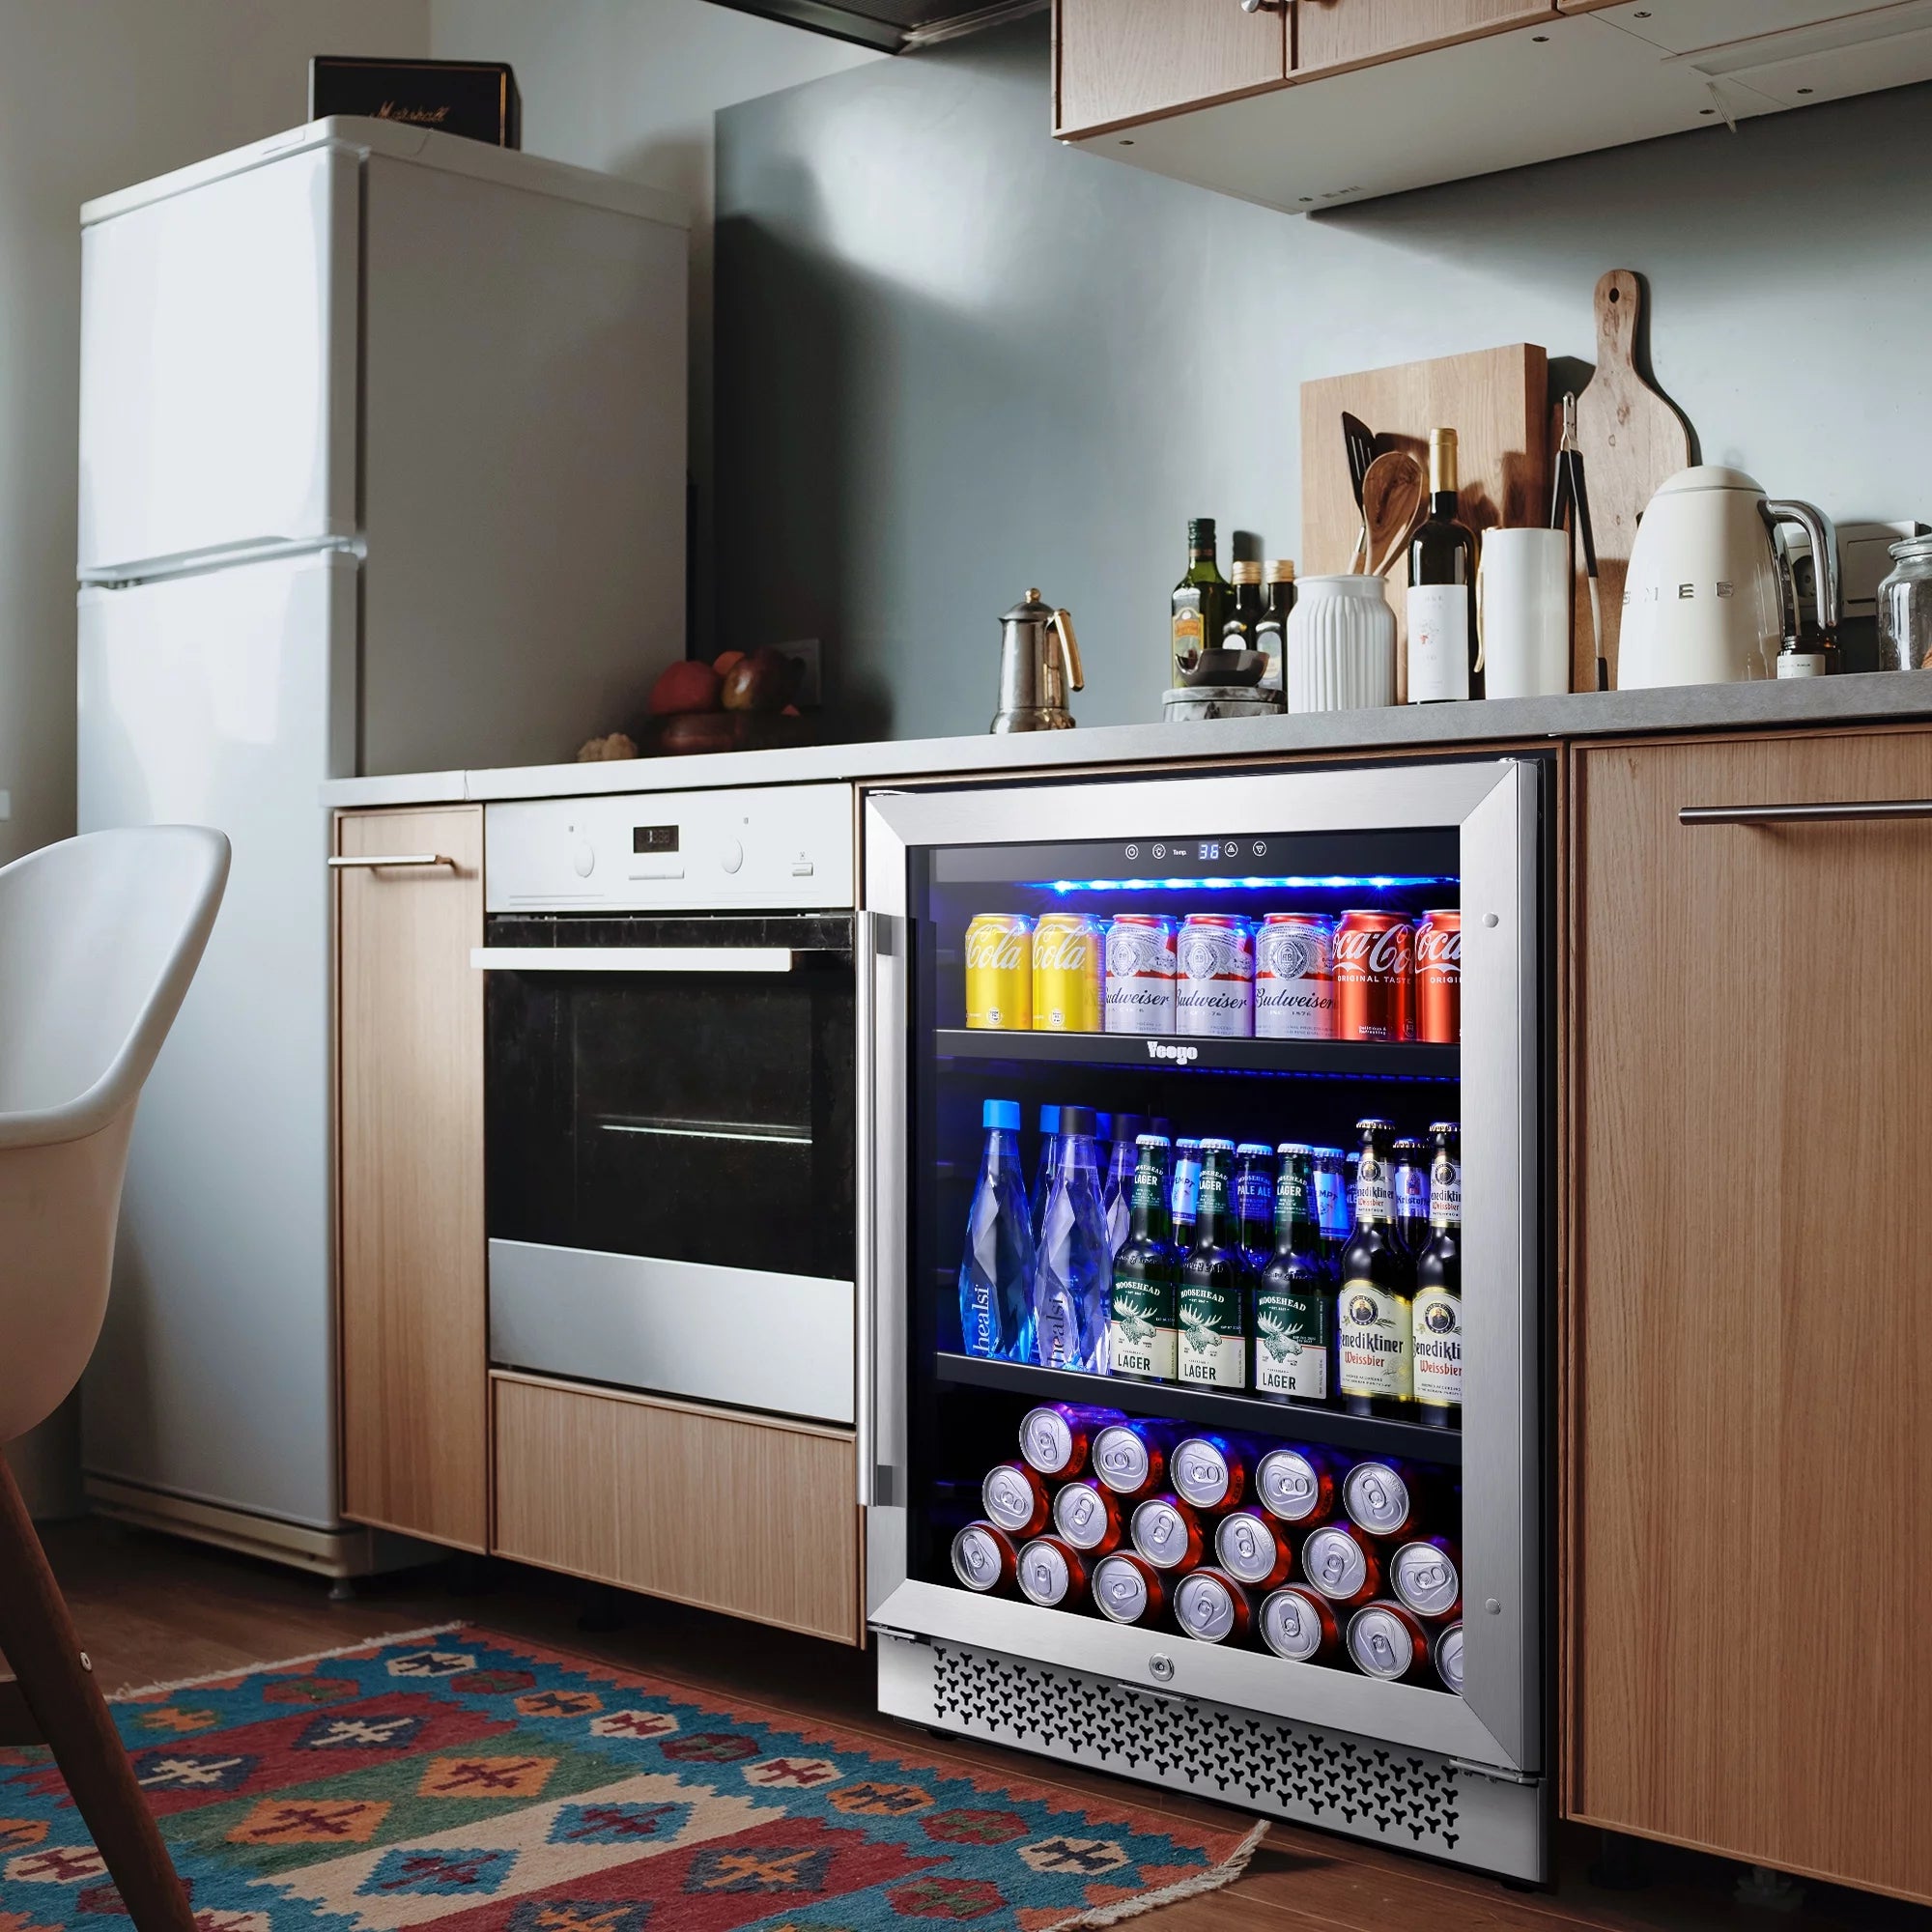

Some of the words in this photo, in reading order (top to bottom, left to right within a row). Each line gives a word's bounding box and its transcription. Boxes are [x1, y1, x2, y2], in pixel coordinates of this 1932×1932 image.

[1200, 844, 1219, 860] 36
[966, 923, 1021, 970] Cola
[1033, 923, 1086, 970] Cola
[1337, 975, 1379, 983] ORIGINAL
[1384, 976, 1411, 984] TASTE
[1430, 976, 1461, 984] ORIGI
[1106, 987, 1169, 1006] udweiser
[1134, 1174, 1158, 1186] LAGER
[1199, 1179, 1222, 1191] LAGER
[1236, 1184, 1256, 1196] PALE
[1257, 1185, 1271, 1198] ALE
[1276, 1185, 1302, 1197] LAGER
[1115, 1281, 1161, 1296] MOOSEHEAD
[1180, 1289, 1225, 1303] MOOSEHEAD
[1259, 1295, 1307, 1312] MOOSEHEAD
[971, 1283, 990, 1352] healsi
[1118, 1353, 1151, 1372] LAGER
[1344, 1350, 1385, 1368] Weissbier
[1183, 1363, 1217, 1381] LAGER
[1419, 1359, 1461, 1377] Weissbier
[1263, 1372, 1296, 1391] LAGER
